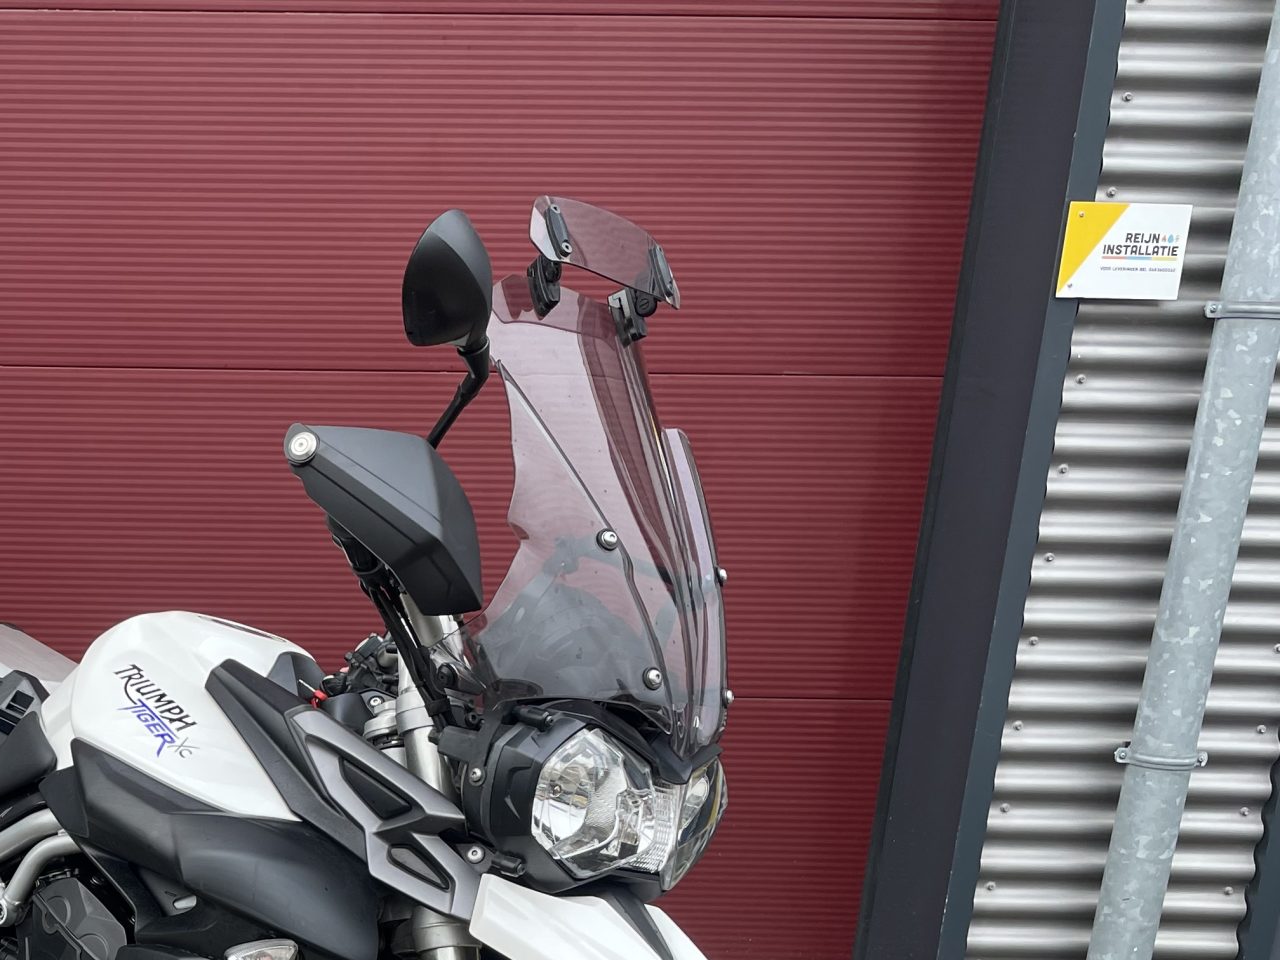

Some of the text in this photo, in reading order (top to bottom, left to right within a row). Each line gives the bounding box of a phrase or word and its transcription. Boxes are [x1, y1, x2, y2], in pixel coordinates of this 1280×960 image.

[1102, 244, 1180, 257] INSTALLATIE
[1125, 232, 1161, 244] REIJN
[113, 663, 198, 732] TRIUMPH
[116, 698, 180, 758] TIGER
